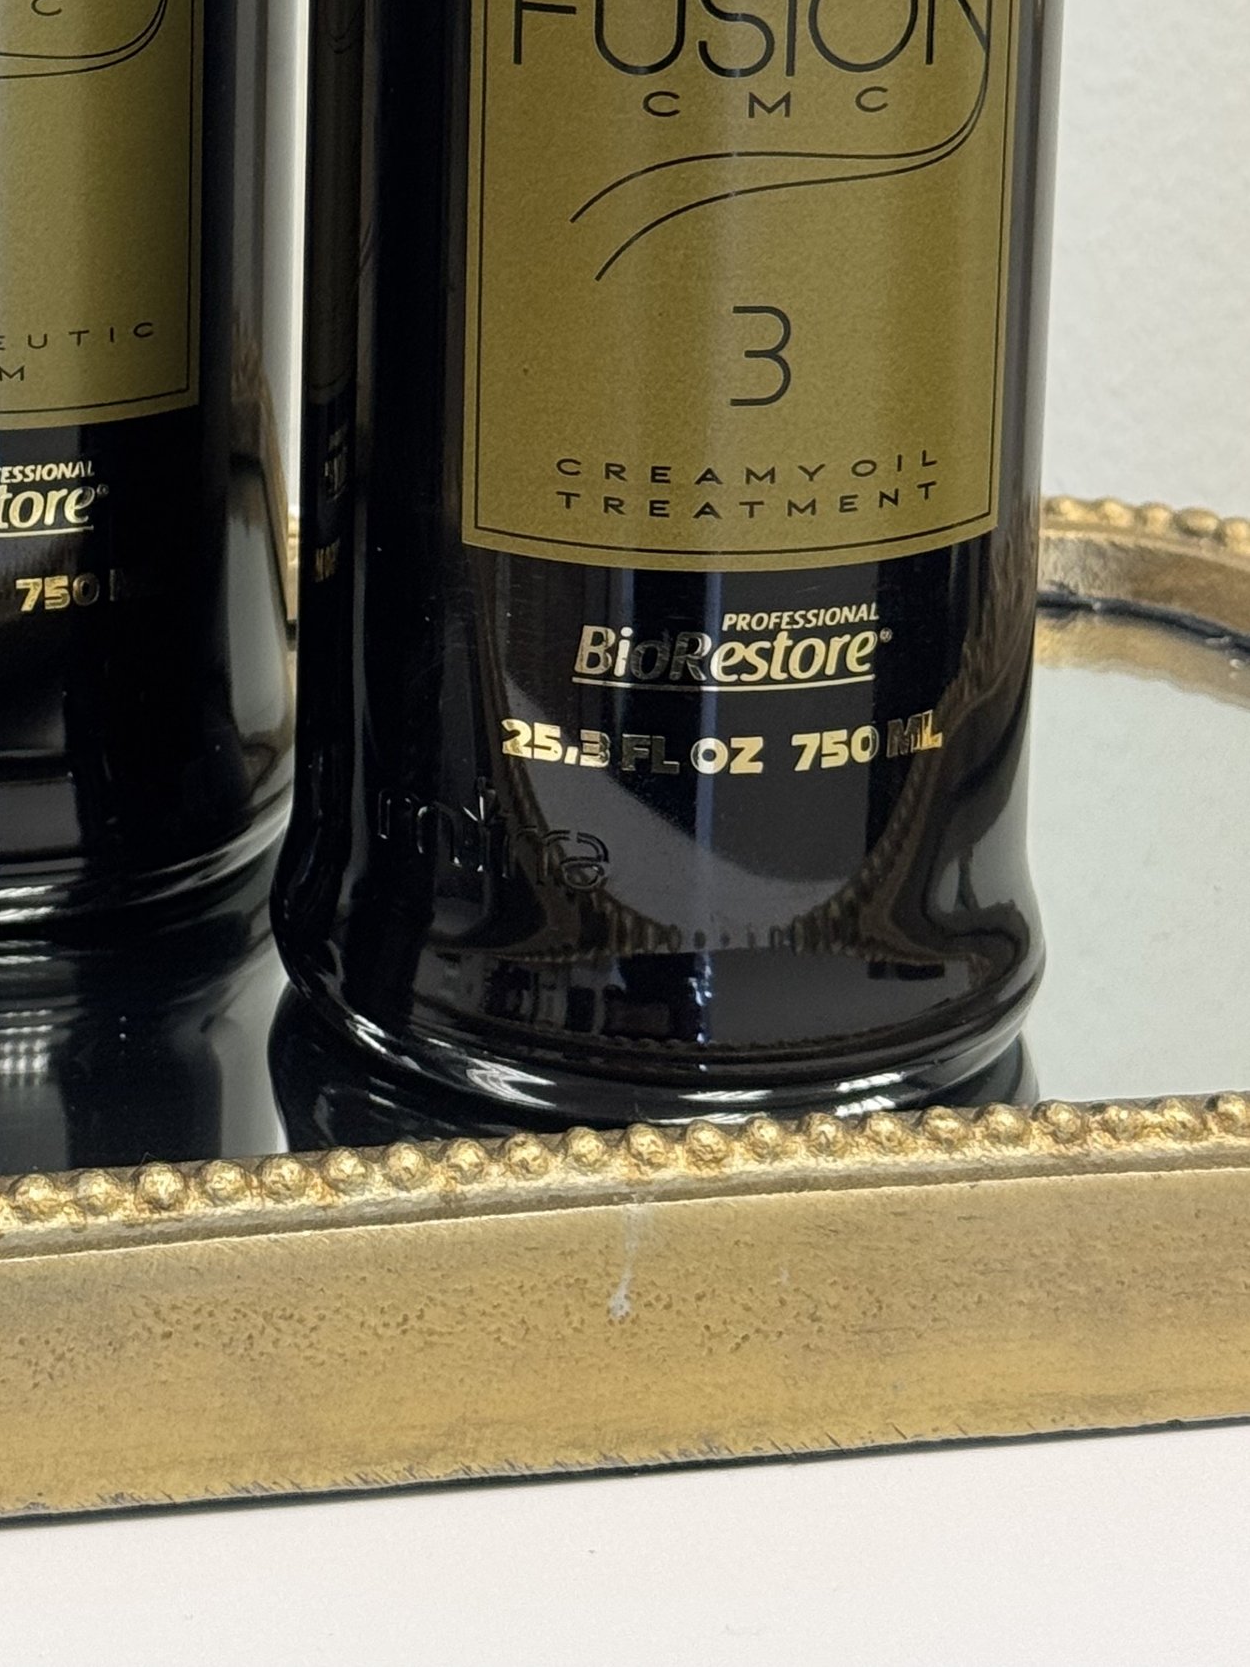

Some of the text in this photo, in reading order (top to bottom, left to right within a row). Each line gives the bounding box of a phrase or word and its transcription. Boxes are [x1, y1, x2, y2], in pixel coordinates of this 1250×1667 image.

[729, 304, 793, 406] 3
[556, 481, 938, 520] TREATMENT
[15, 572, 100, 613] 750
[721, 602, 880, 632] PROFESSIONAL
[621, 733, 680, 775] FL
[690, 736, 764, 775] OZ
[791, 724, 880, 772] 750
[886, 708, 943, 758] ML
